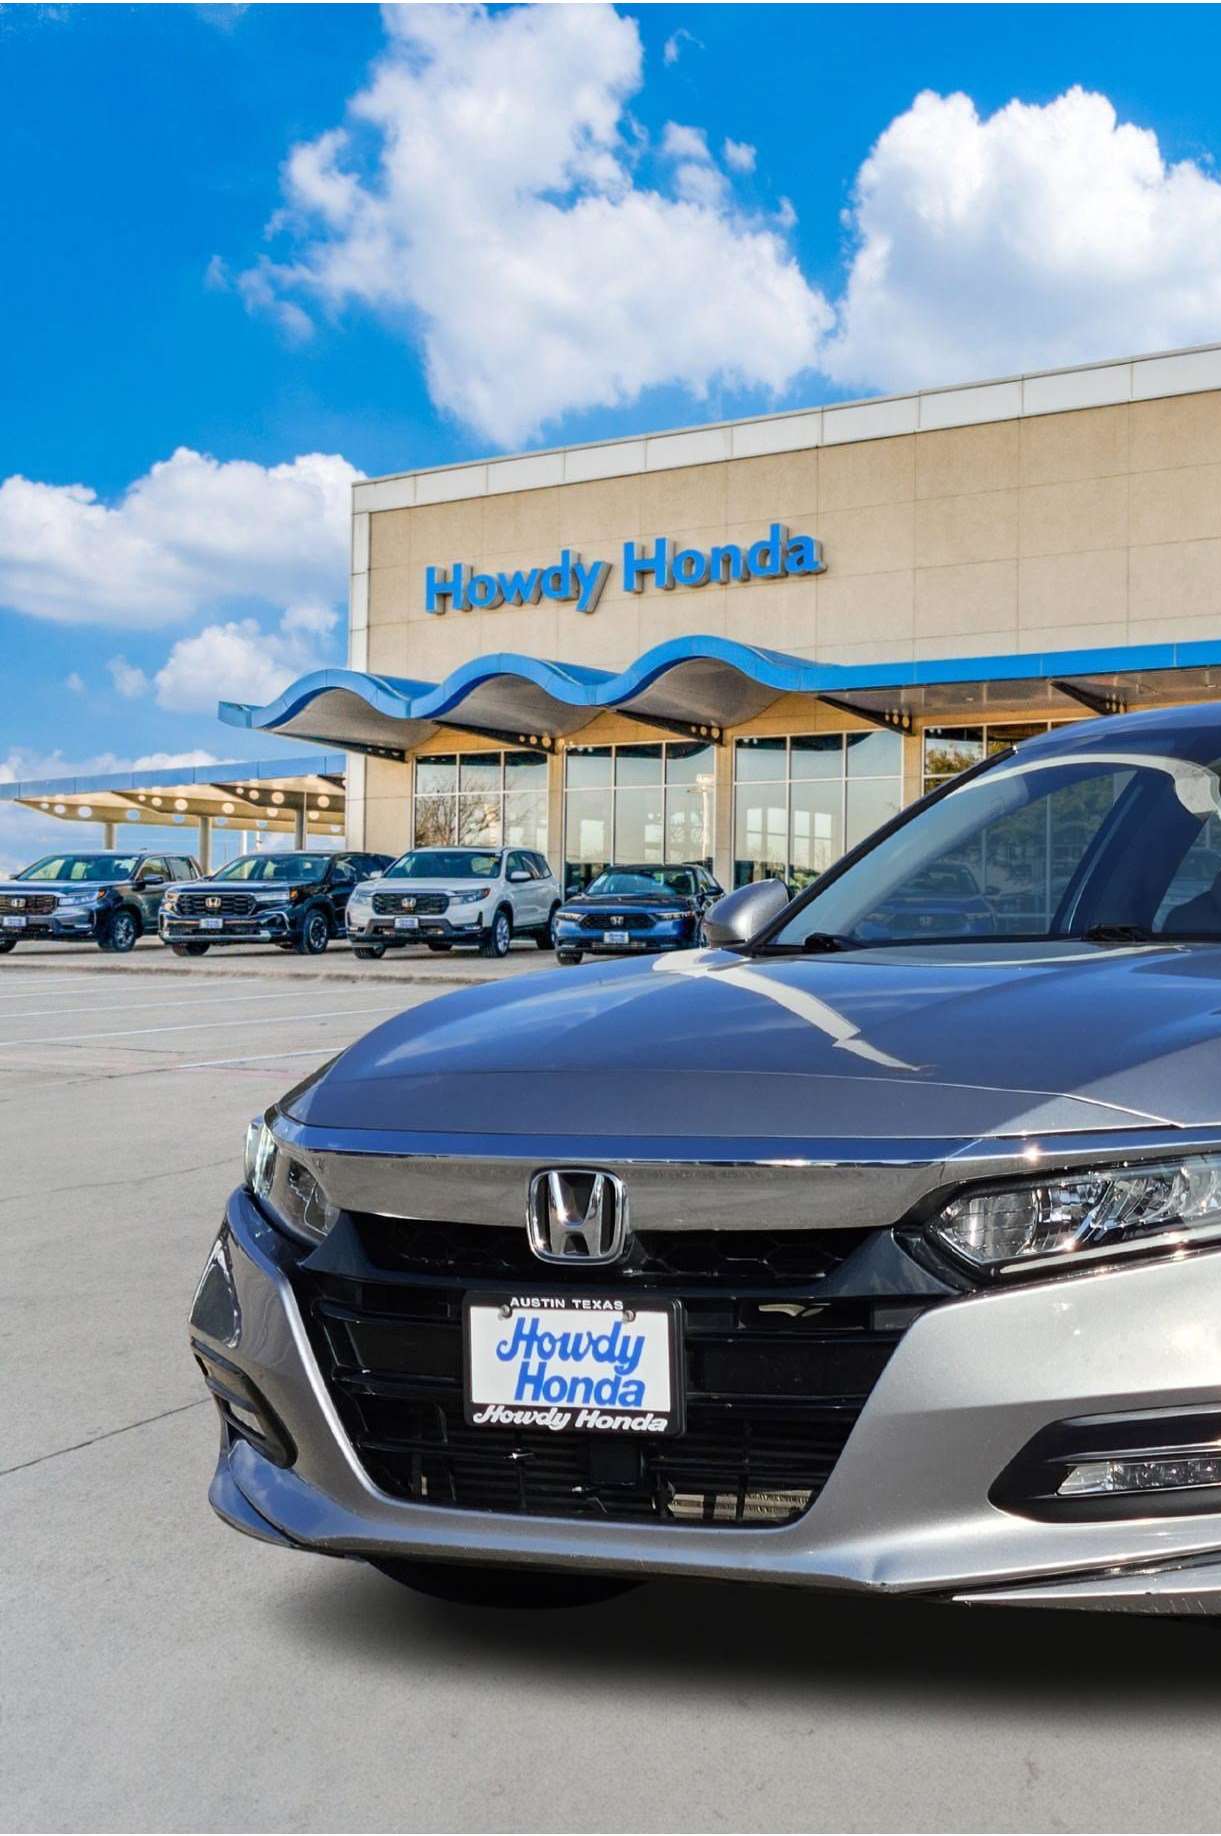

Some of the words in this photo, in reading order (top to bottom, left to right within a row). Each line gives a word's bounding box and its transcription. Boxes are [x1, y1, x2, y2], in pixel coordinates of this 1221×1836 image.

[425, 549, 610, 615] Howdy
[622, 523, 826, 594] Honda
[510, 1297, 566, 1309] AUSTIN
[572, 1299, 624, 1310] TEXAS
[496, 1316, 646, 1376] Howdy
[514, 1361, 646, 1408] Honda
[473, 1405, 571, 1431] Howdy
[575, 1409, 668, 1432] Honda
